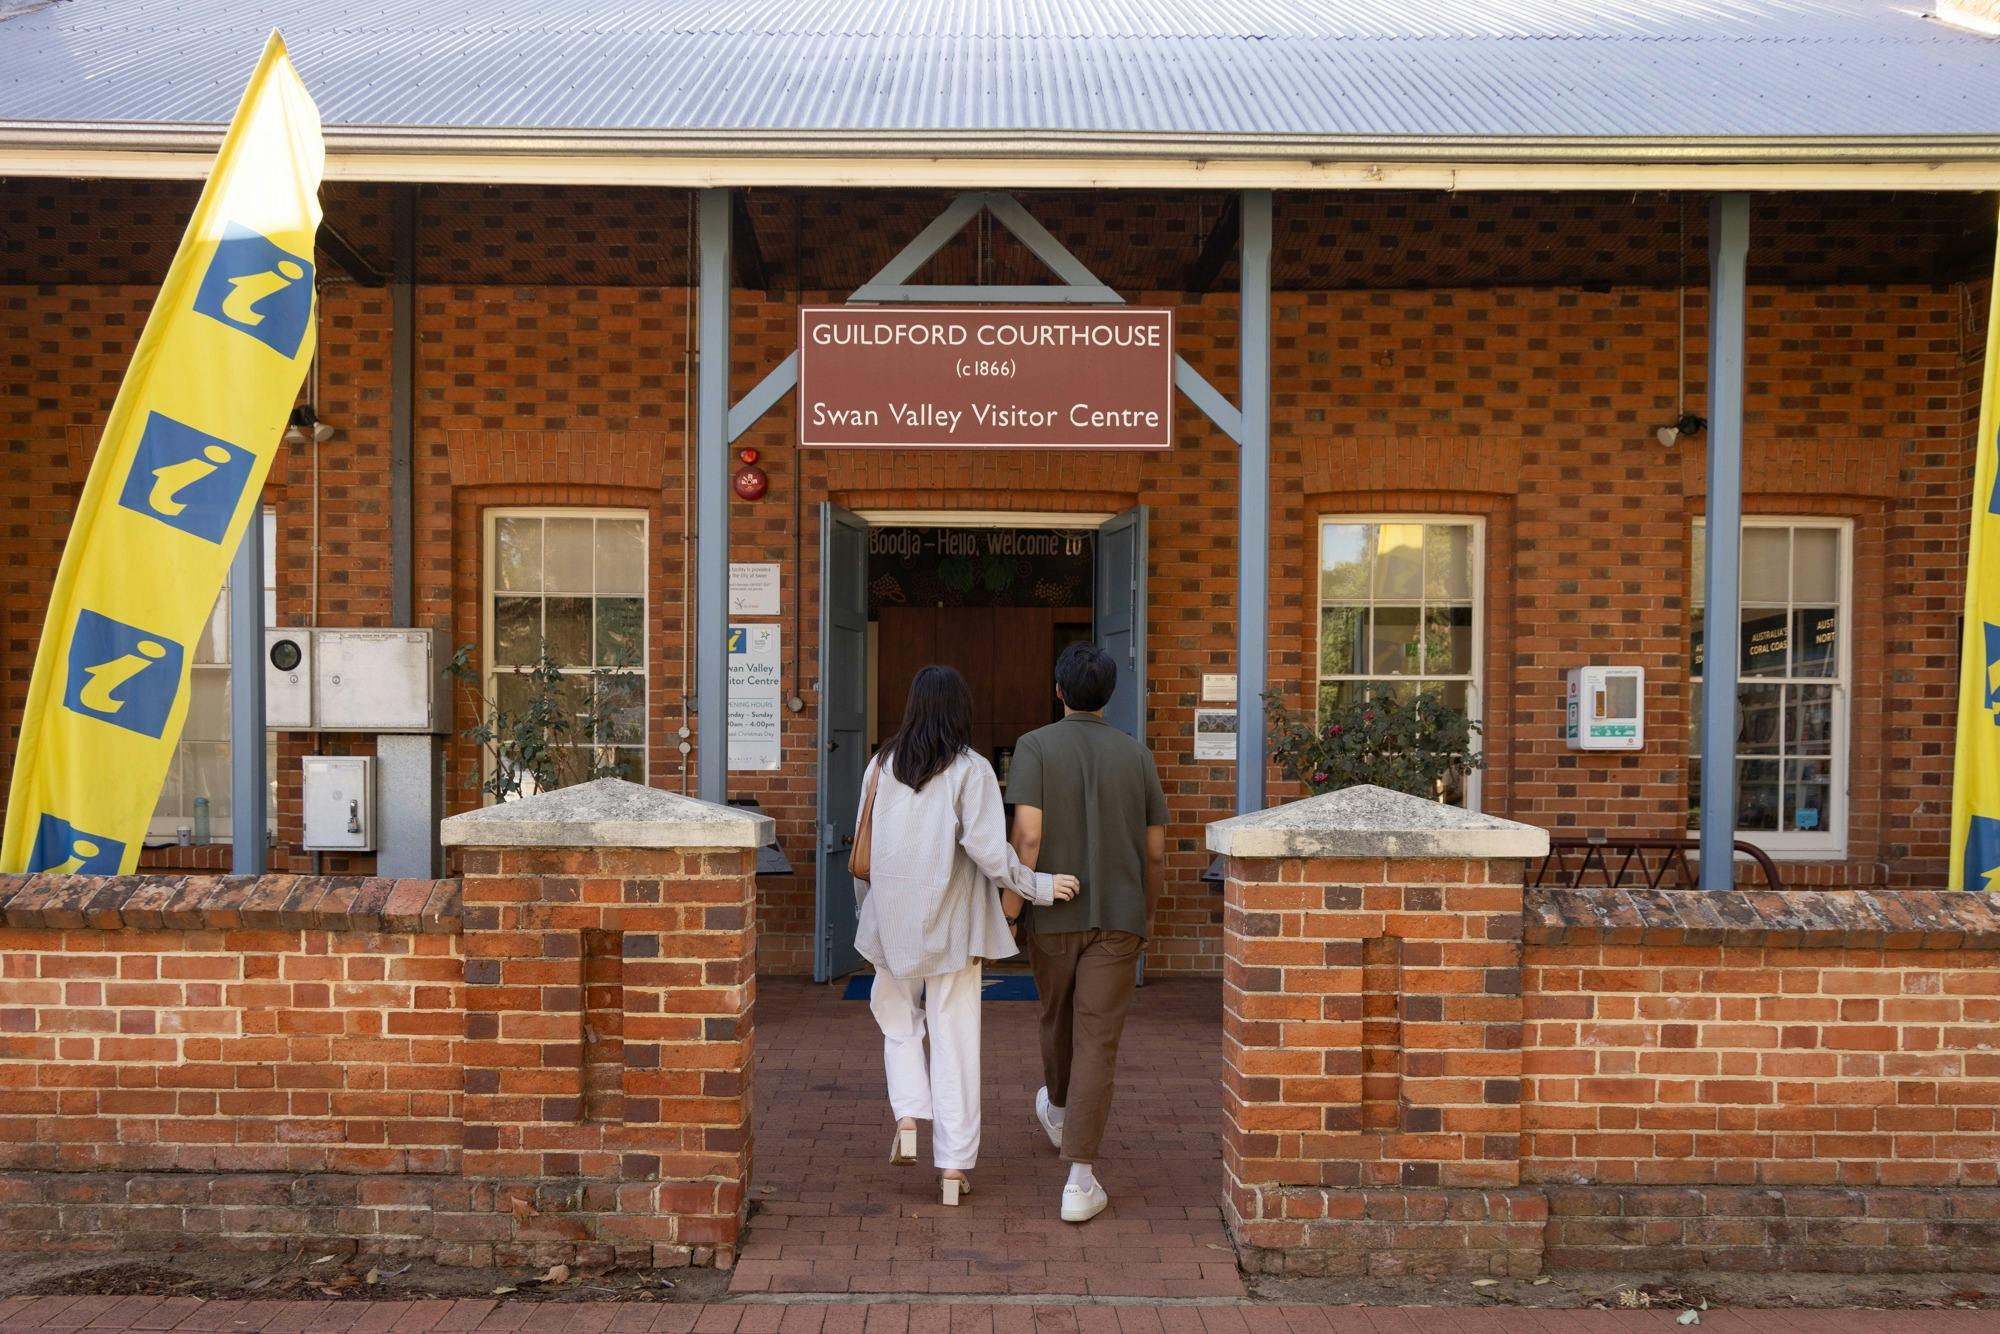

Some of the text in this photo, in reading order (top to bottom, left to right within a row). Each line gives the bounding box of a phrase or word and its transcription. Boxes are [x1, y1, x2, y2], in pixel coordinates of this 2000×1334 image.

[812, 324, 1160, 347] GUILDFORD COURTHOUSE
[812, 402, 1159, 433] Swan Valley Visitor Centre
[869, 530, 920, 560] Boodja
[729, 676, 779, 685] itor Centre
[746, 664, 774, 676] Valley
